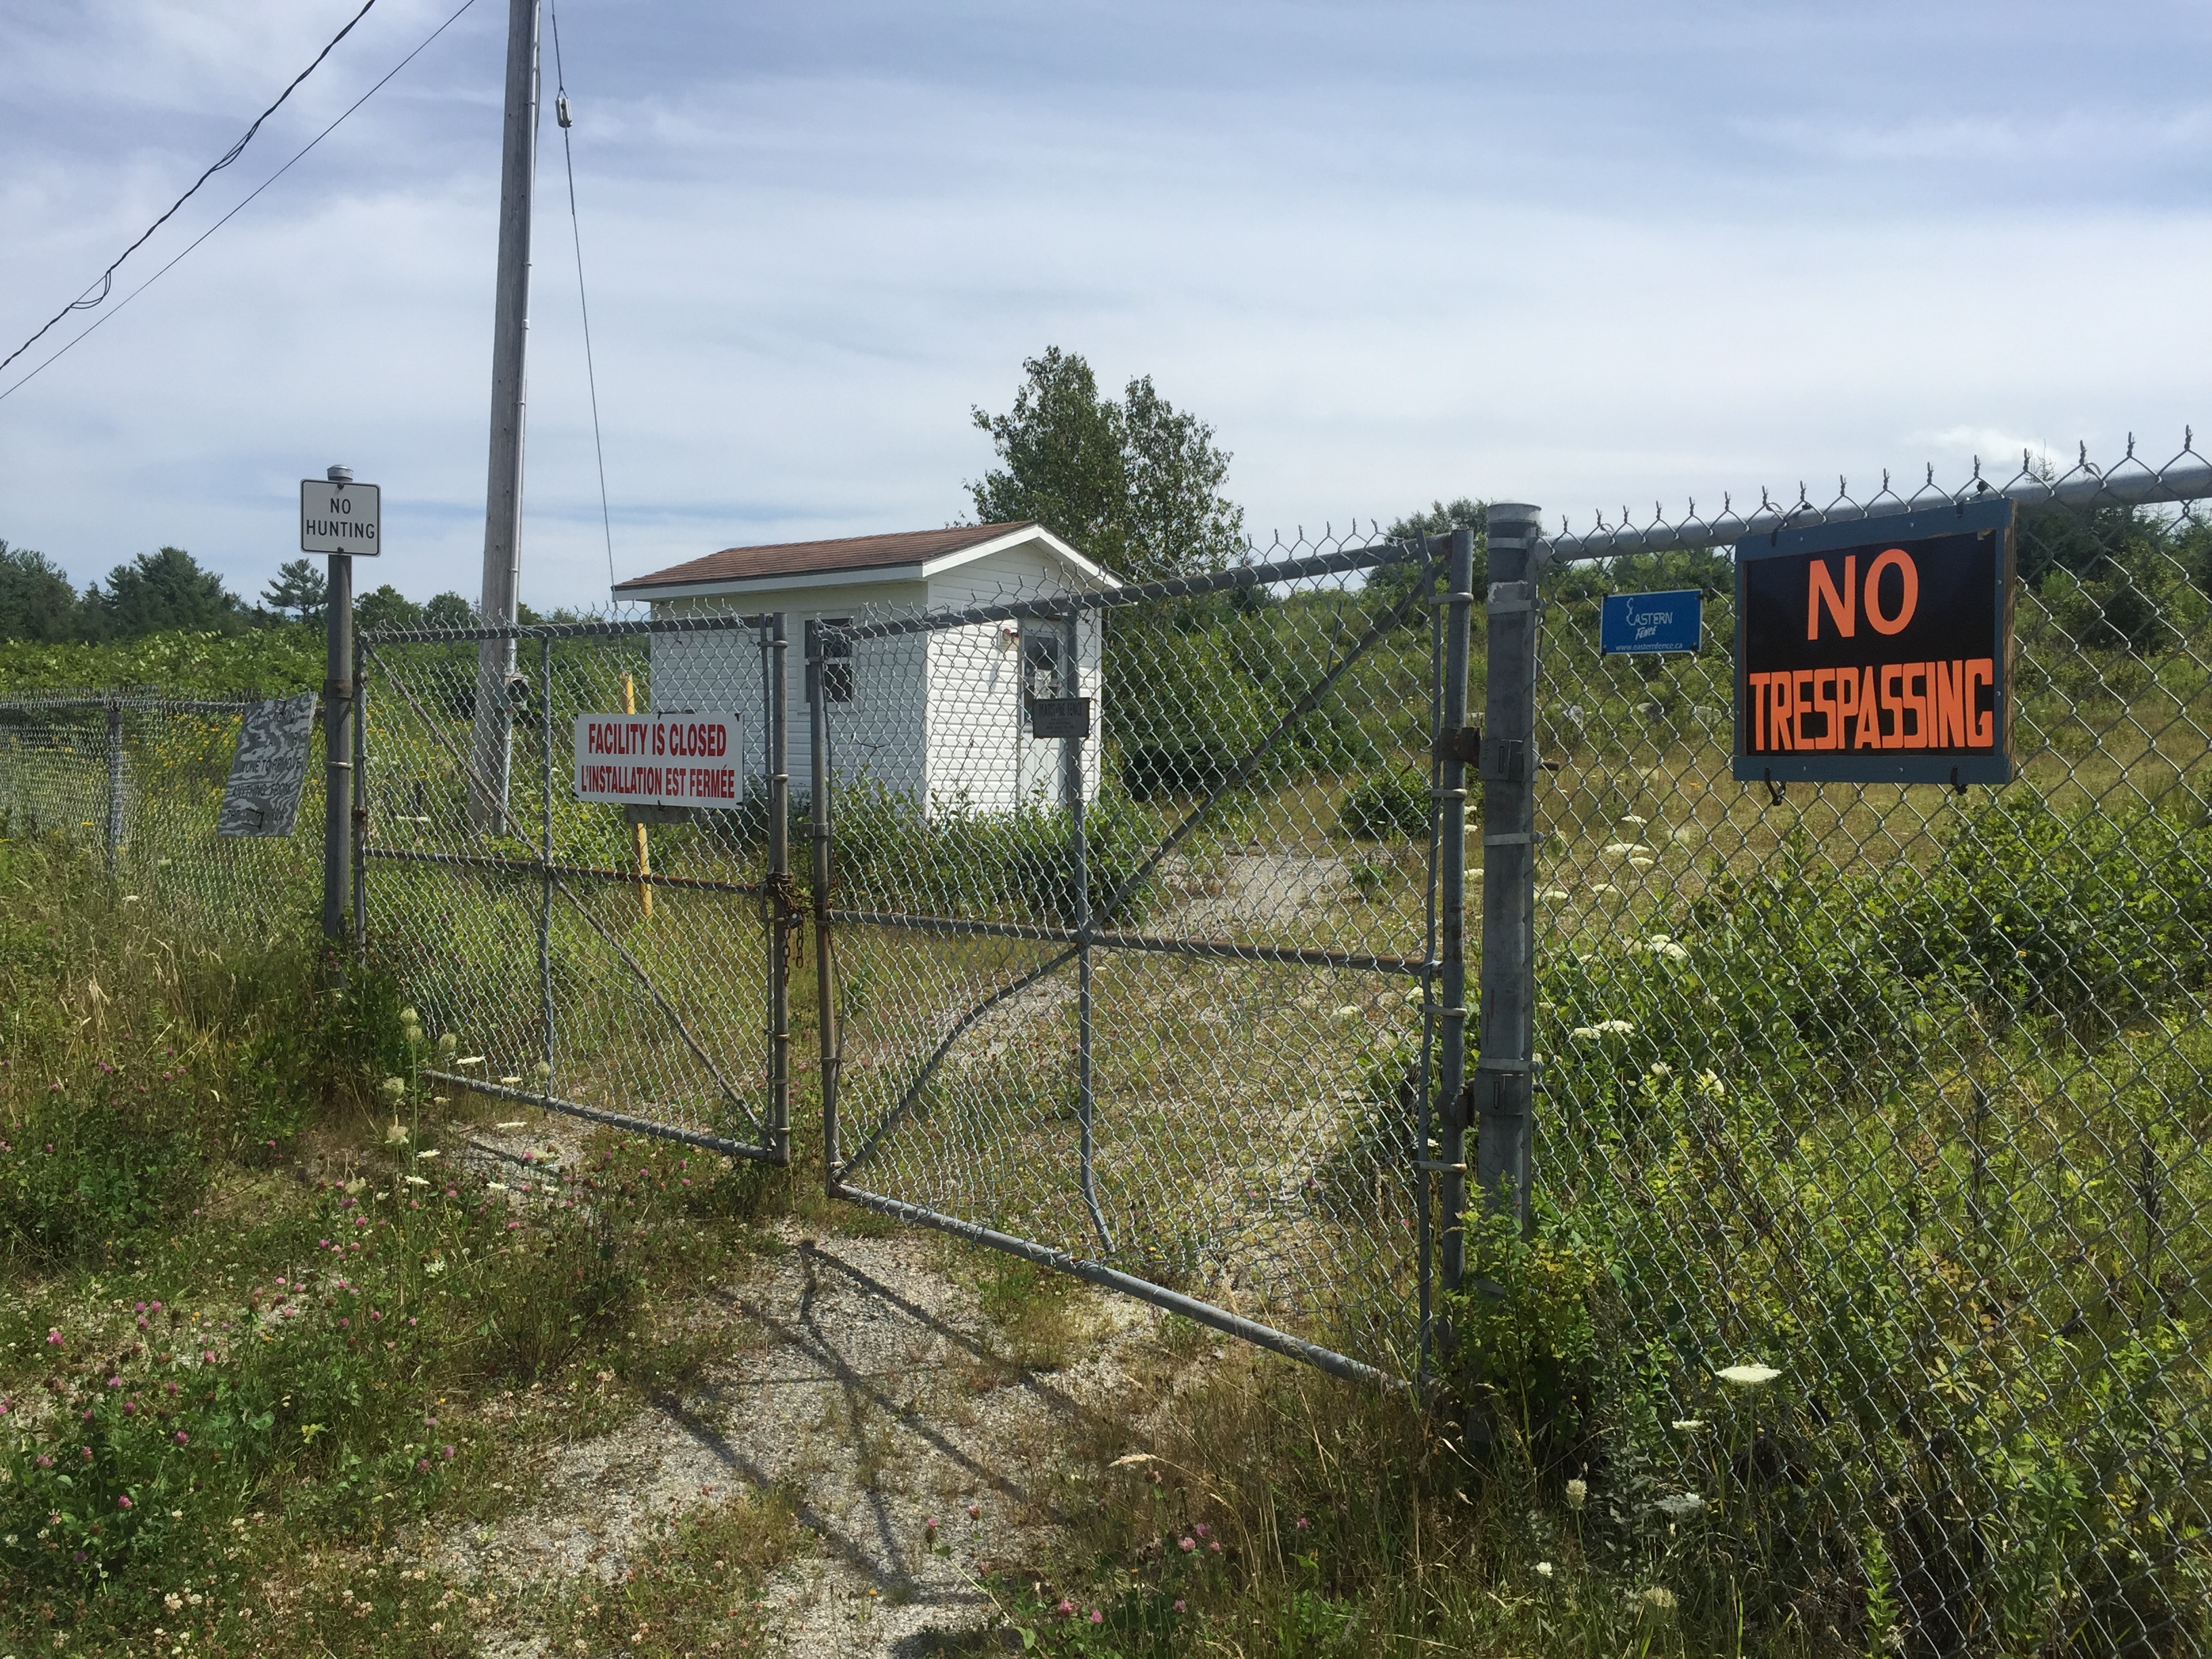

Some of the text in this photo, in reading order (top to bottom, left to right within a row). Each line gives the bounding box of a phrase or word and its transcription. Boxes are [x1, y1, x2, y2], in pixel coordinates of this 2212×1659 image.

[330, 497, 351, 514] NO
[306, 519, 375, 539] HUNTING
[1807, 548, 1919, 641] NO
[1626, 597, 1673, 626] EASTERN
[1615, 642, 1683, 651] www.easternfence.ca
[1749, 658, 1994, 752] TRESPASSING
[588, 723, 727, 757] FACILITY IS CLOSED
[581, 764, 735, 798] L'INSTALLATION EST FERMÉE
